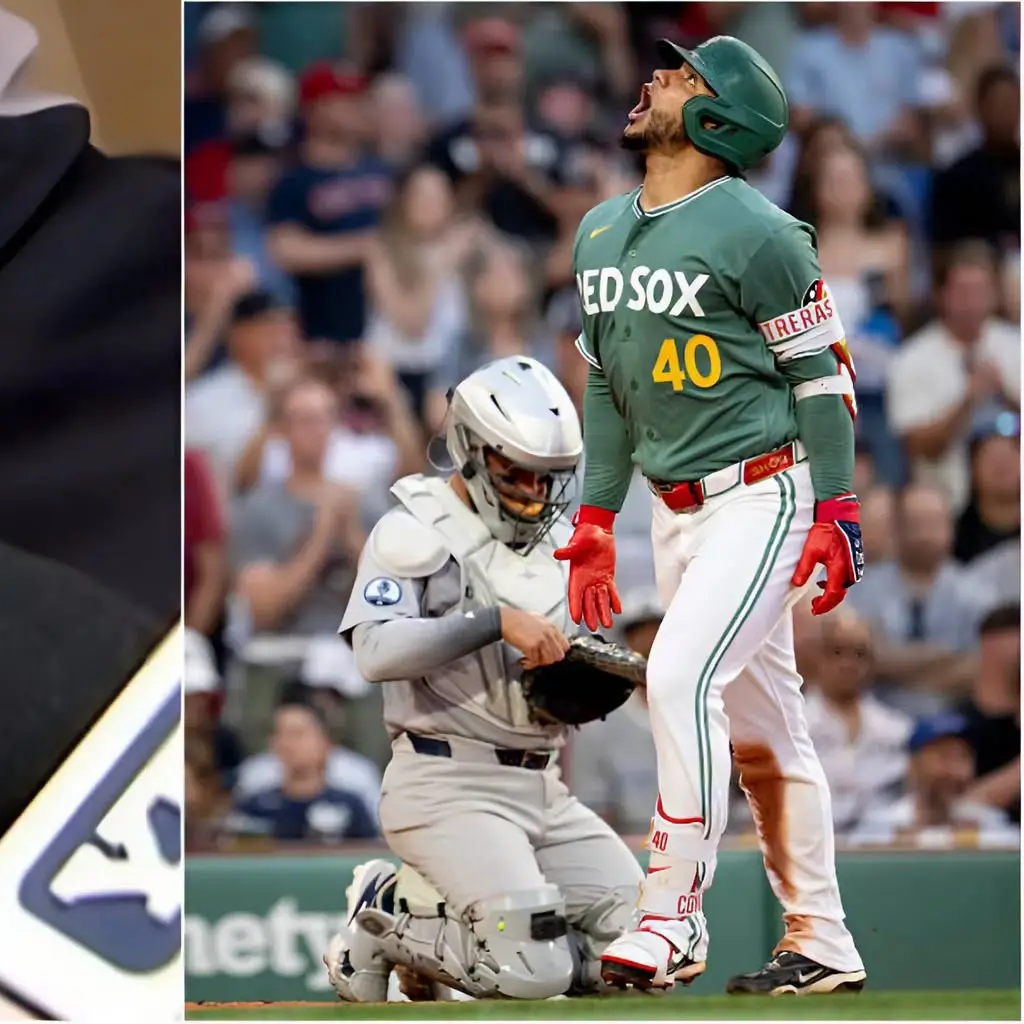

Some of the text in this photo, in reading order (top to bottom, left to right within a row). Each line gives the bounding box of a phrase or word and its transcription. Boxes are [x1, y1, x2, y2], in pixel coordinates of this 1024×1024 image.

[626, 265, 710, 317] SOX
[758, 299, 834, 341] TRERAS
[652, 334, 722, 391] 40
[652, 830, 669, 852] 40
